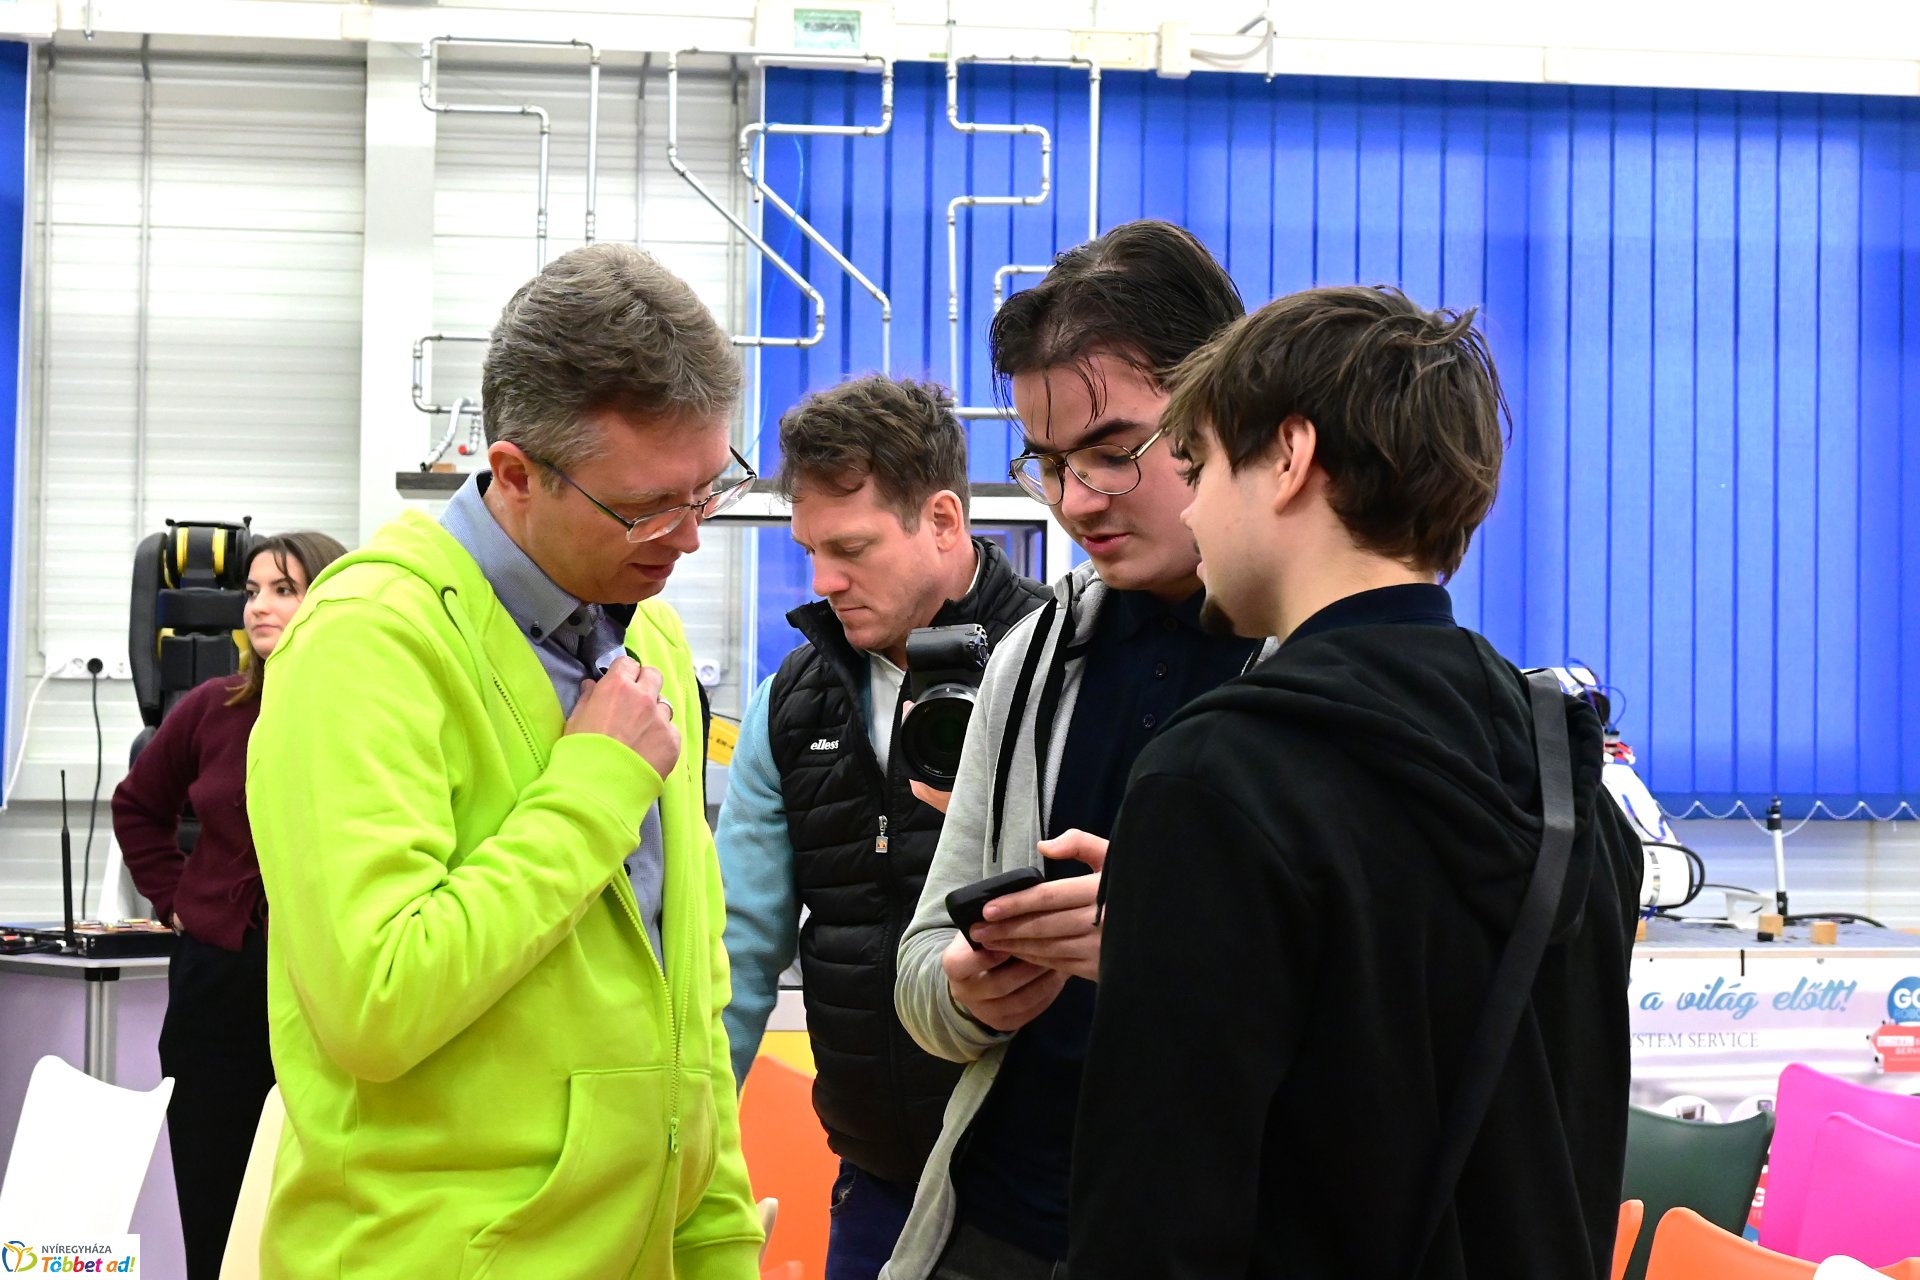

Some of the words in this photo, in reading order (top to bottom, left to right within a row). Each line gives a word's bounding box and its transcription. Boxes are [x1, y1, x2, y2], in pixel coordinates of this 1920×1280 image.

[1639, 991, 1664, 1011] a
[1676, 976, 1759, 1020] világ
[1772, 976, 1858, 1013] előtt!
[1688, 1031, 1759, 1048] SERVICE
